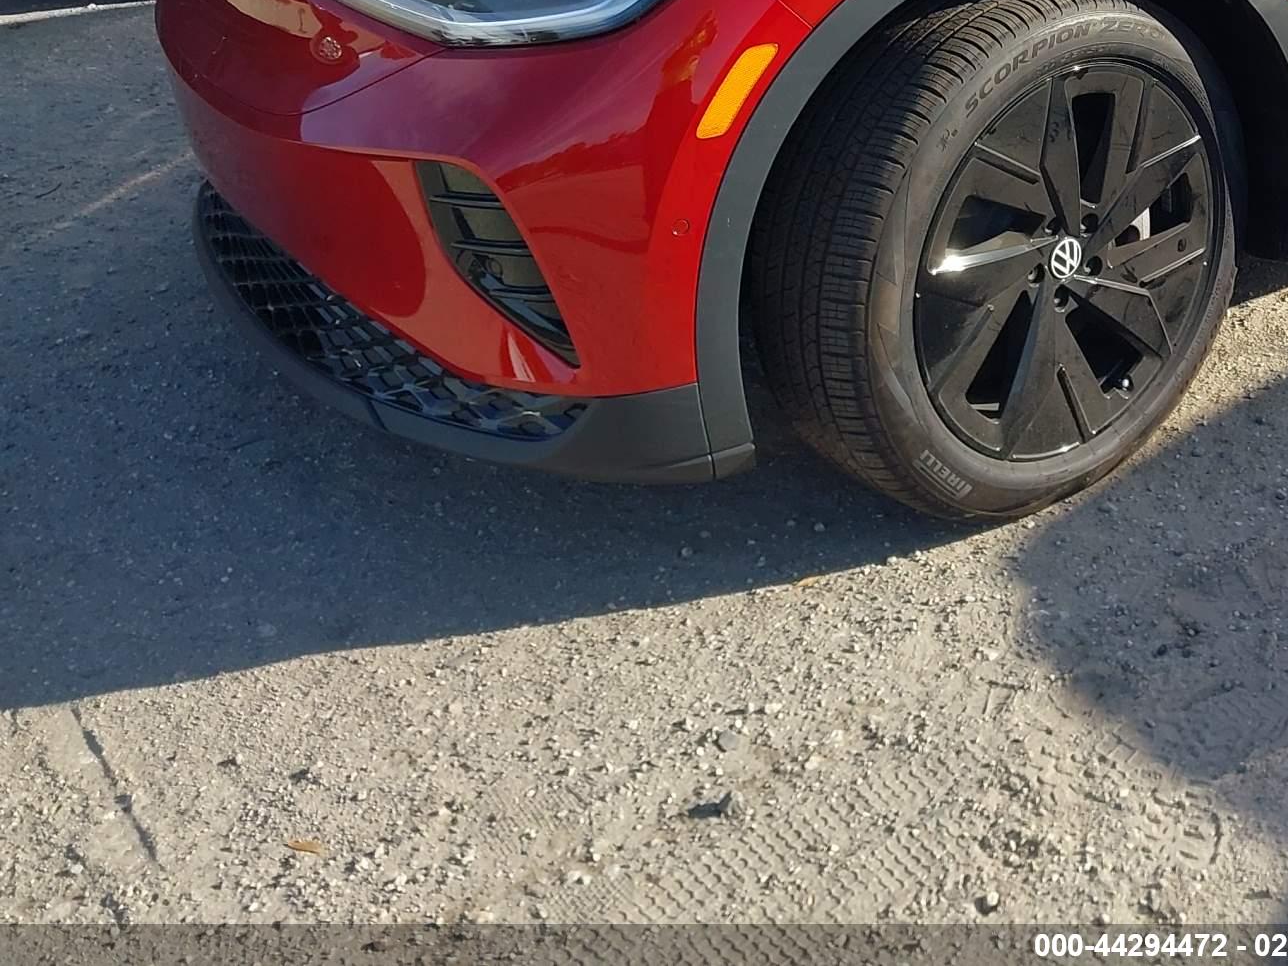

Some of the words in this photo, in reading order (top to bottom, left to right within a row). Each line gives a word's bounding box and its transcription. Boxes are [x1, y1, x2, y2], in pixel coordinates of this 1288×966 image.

[963, 22, 1092, 120] SCORPION
[1098, 17, 1165, 40] ZERO
[912, 449, 975, 501] PIRELLI
